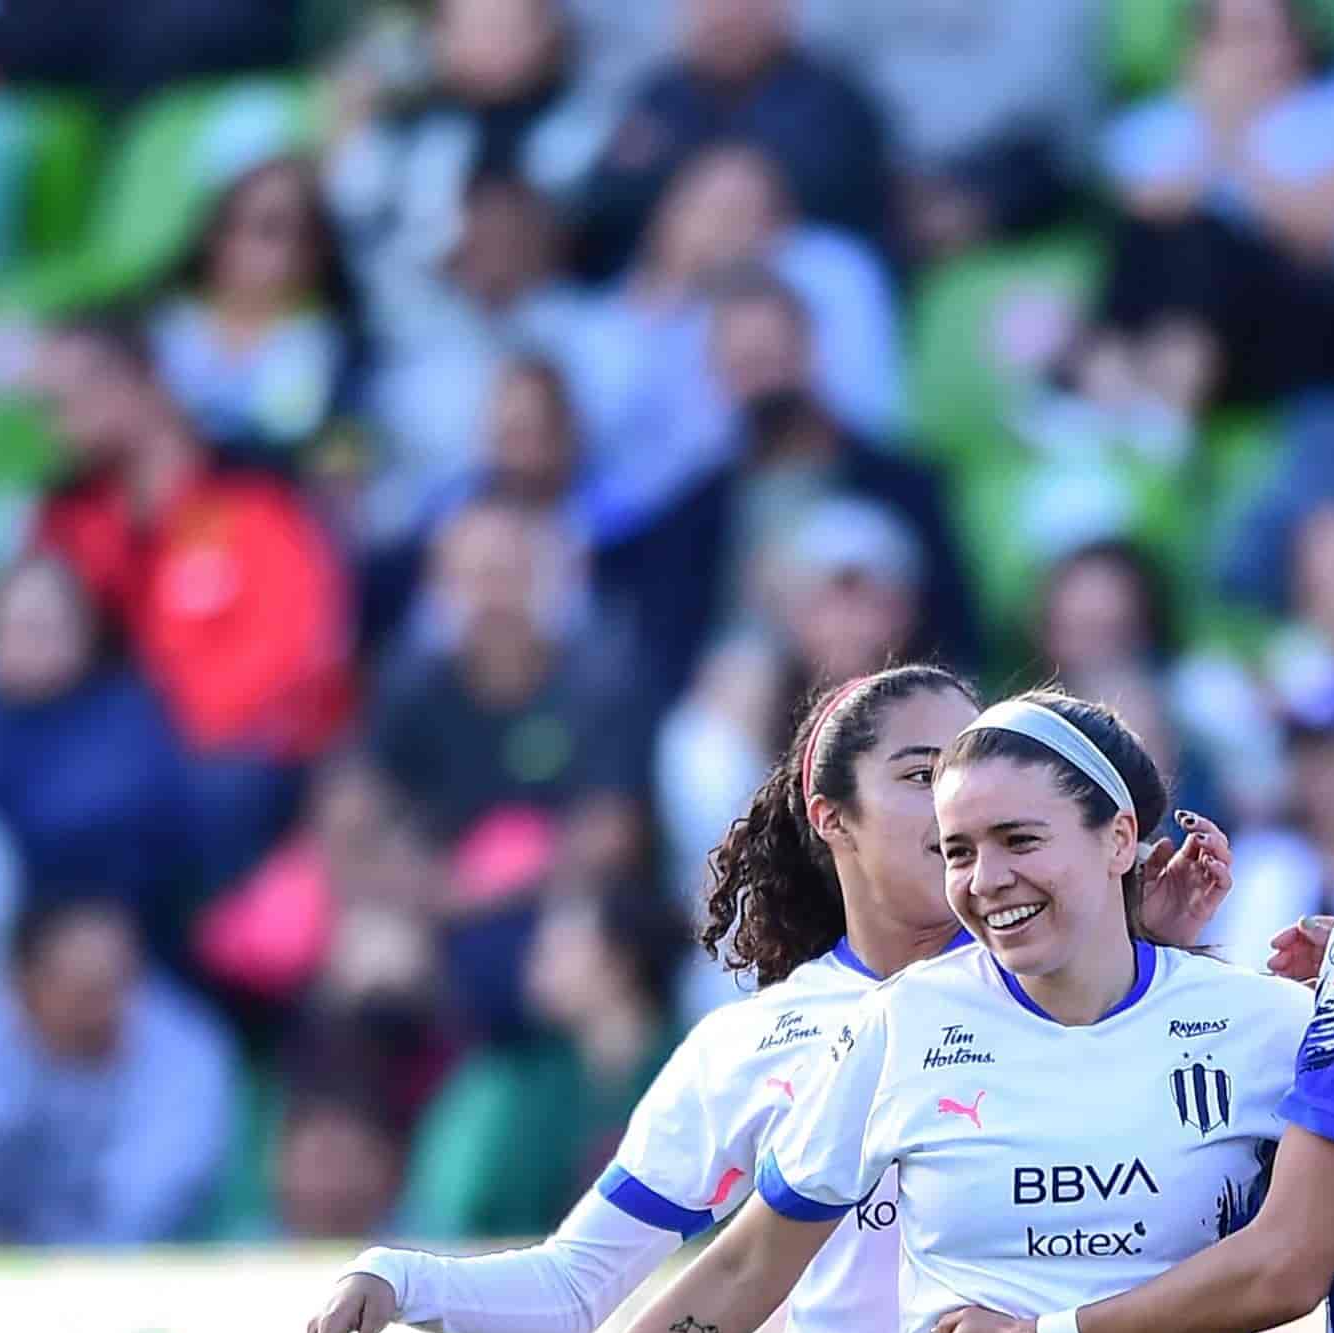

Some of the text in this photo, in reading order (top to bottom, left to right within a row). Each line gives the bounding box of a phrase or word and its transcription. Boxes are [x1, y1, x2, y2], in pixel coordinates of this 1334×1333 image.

[941, 1024, 975, 1046] Tim
[1013, 1157, 1160, 1204] BBVA
[856, 1201, 900, 1230] ko
